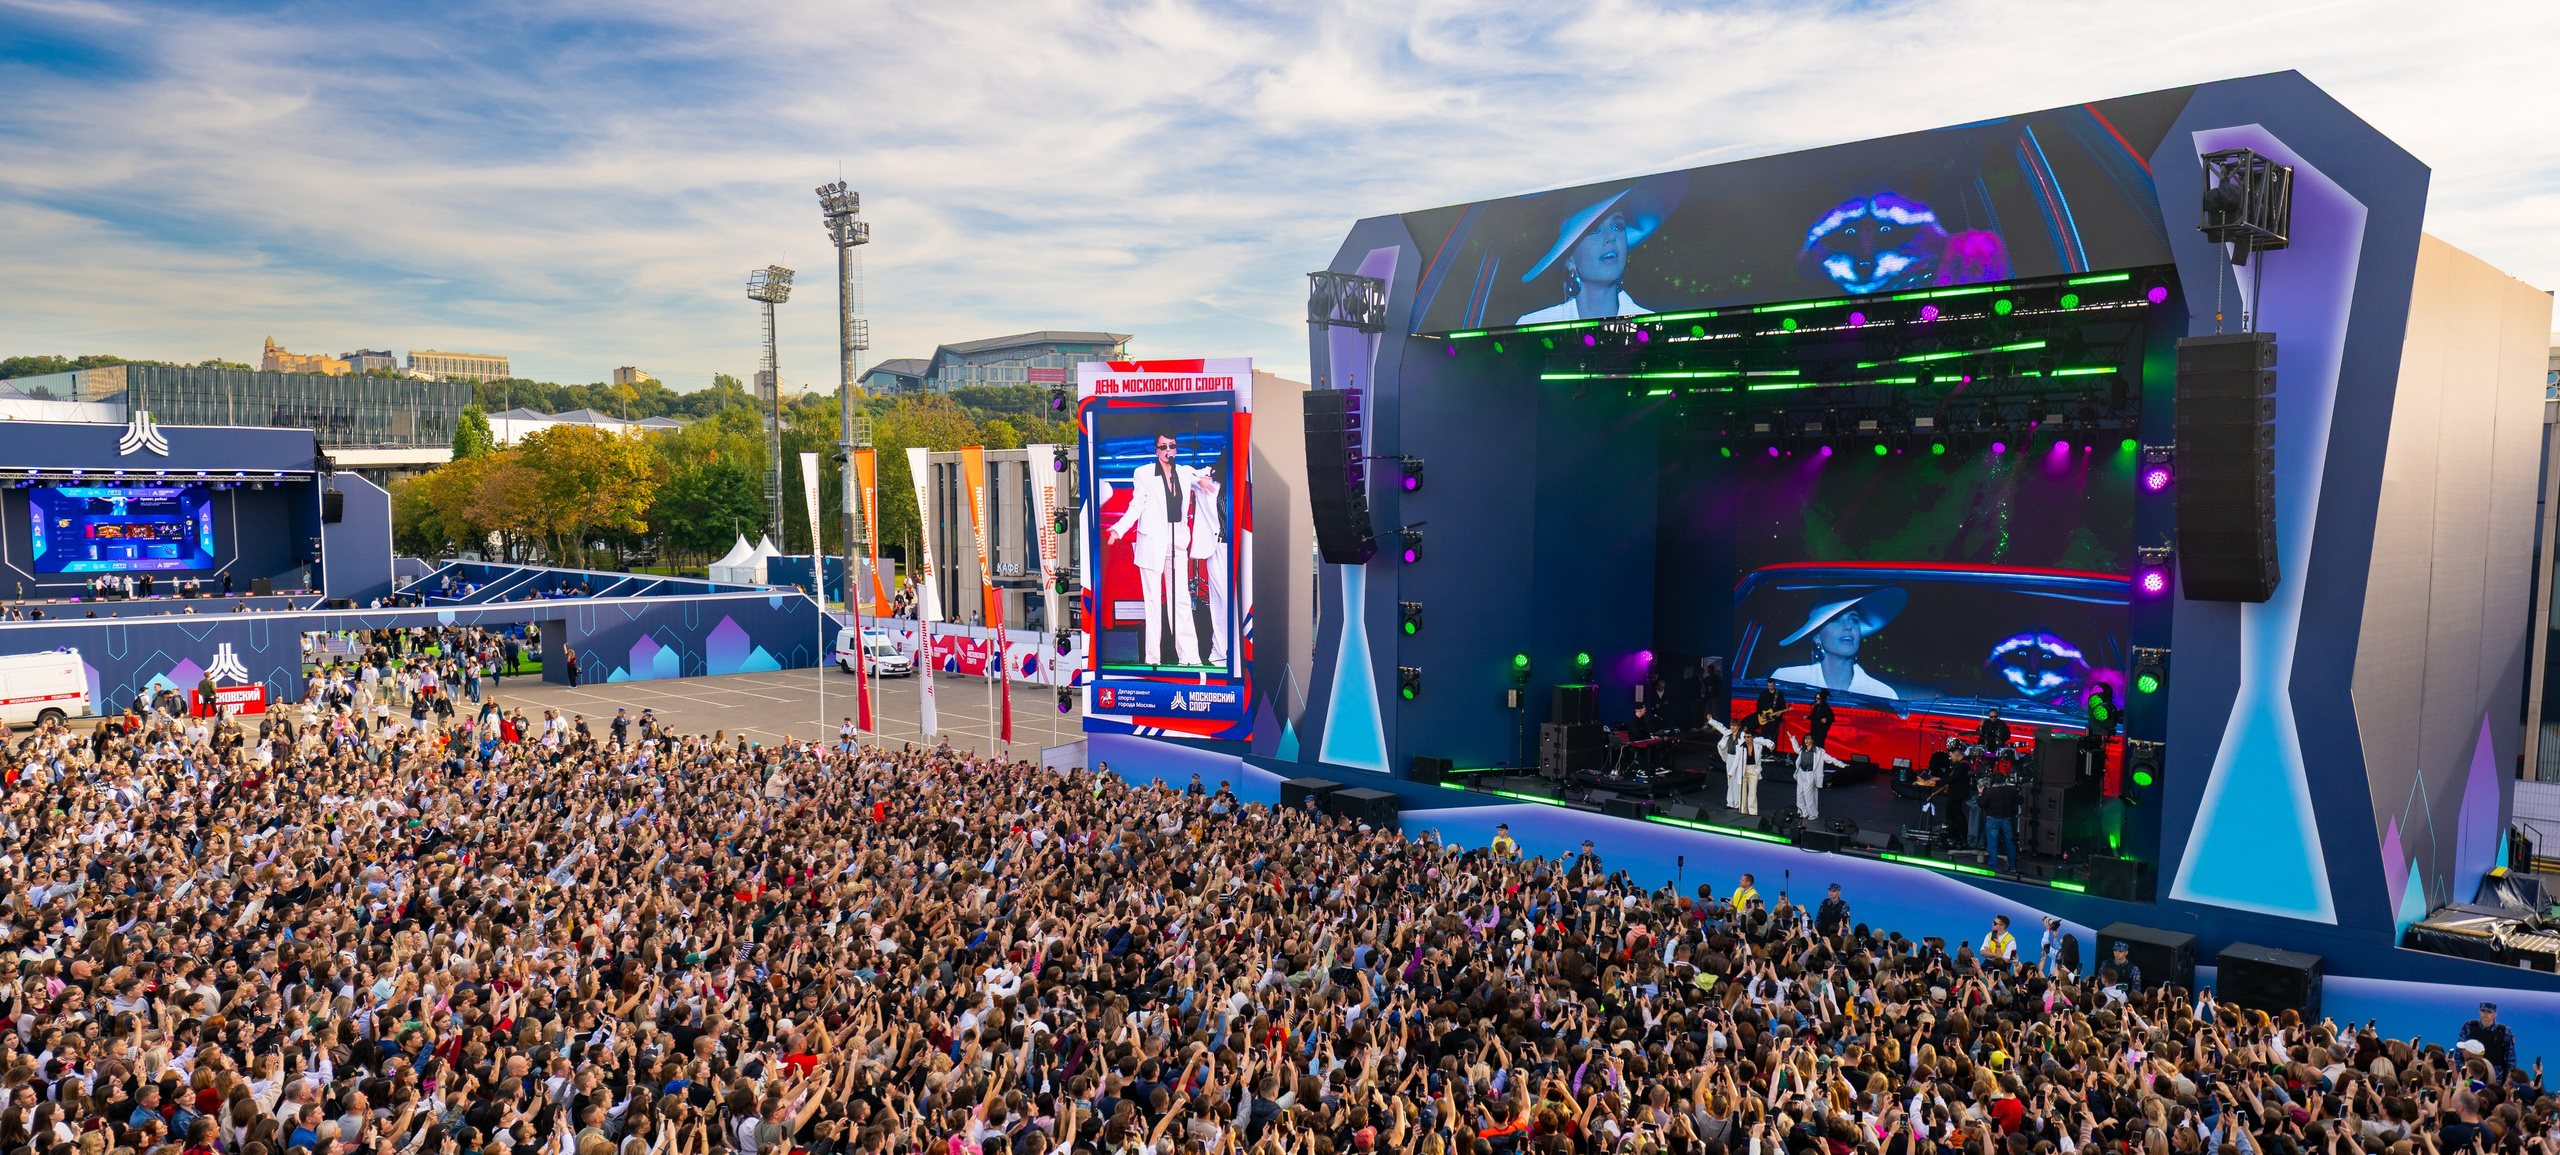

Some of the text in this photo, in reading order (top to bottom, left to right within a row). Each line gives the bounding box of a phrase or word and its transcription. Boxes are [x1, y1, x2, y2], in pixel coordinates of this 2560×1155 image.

[1095, 376, 1233, 395] ДЕНЬ МОСКОВСКОГО СПОРТА
[996, 562, 1020, 573] КАФЕ
[198, 688, 260, 704] МСКОВСКИЙ
[1189, 691, 1236, 703] МОСКОВСКИЙ
[1189, 701, 1211, 712] СПОРТ
